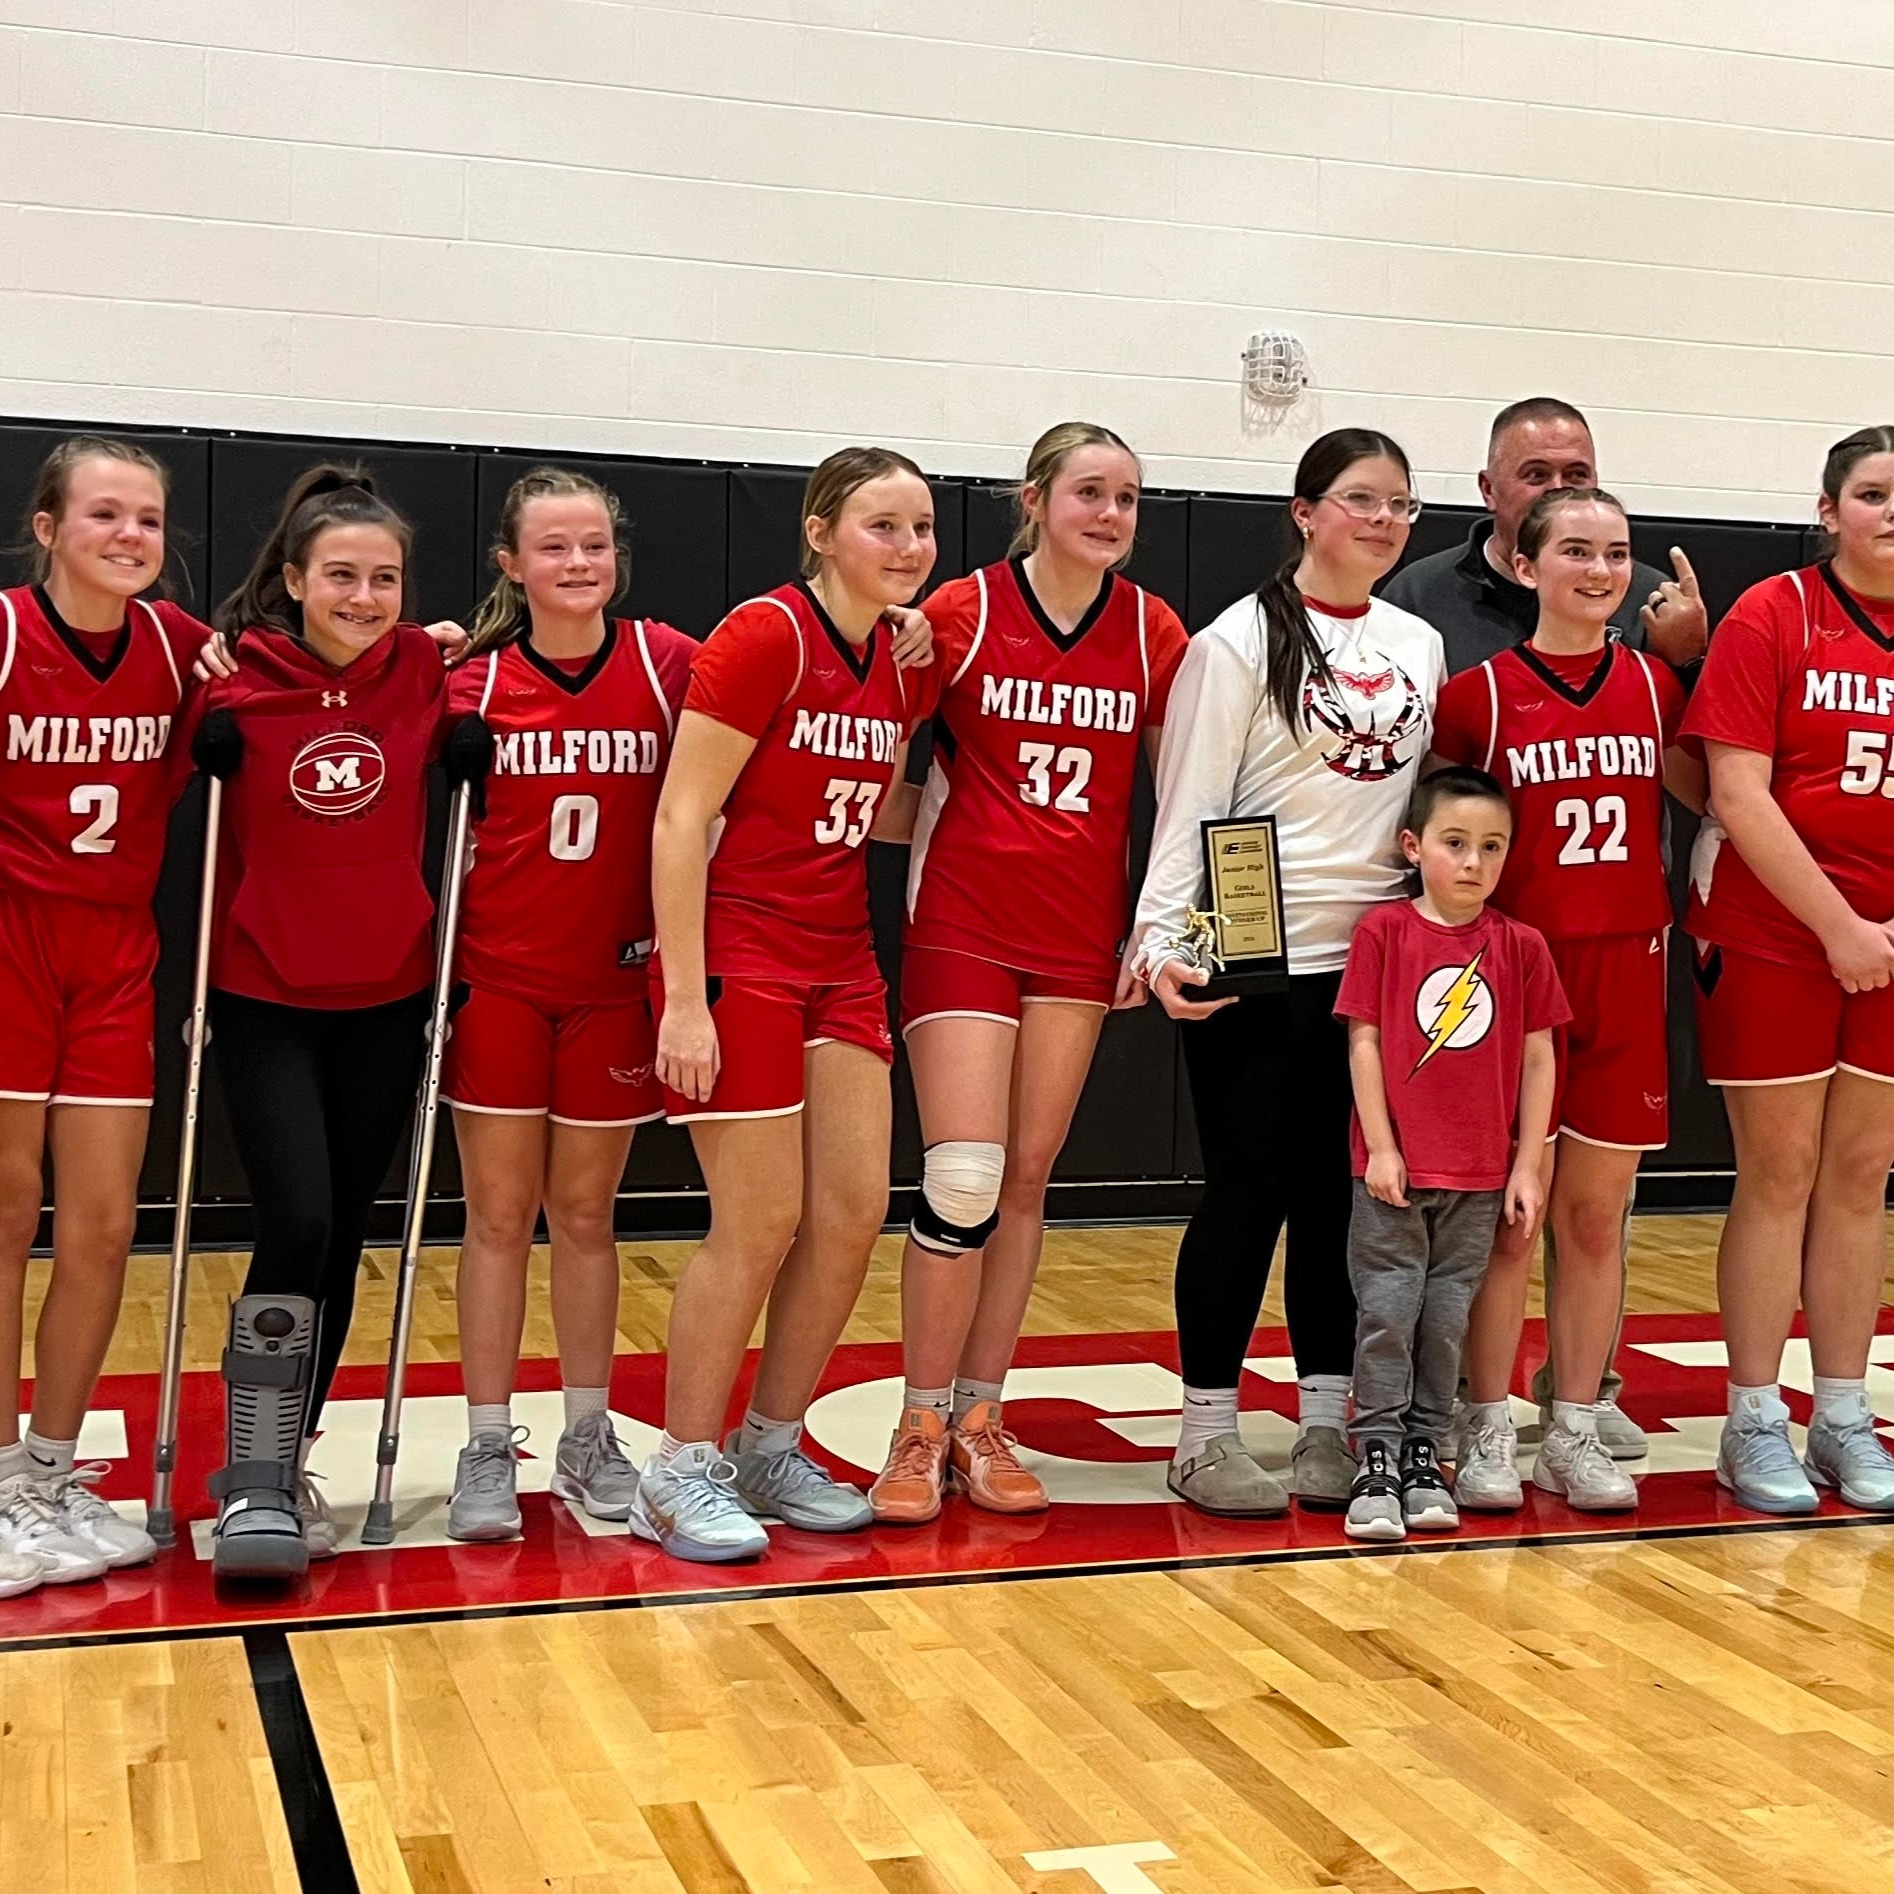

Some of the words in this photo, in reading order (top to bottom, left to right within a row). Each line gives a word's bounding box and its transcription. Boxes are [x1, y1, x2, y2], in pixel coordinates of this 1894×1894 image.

[980, 674, 1137, 733] MILFORD
[7, 714, 171, 763] MILFORD
[493, 730, 658, 775] MILFORD
[1506, 735, 1656, 788] MILFORD
[1840, 730, 1894, 799] 5
[315, 757, 361, 791] M
[1018, 741, 1092, 813] 32
[69, 784, 119, 853] 2
[549, 795, 599, 860] 0
[815, 778, 882, 849] 33
[1555, 795, 1628, 865] 22
